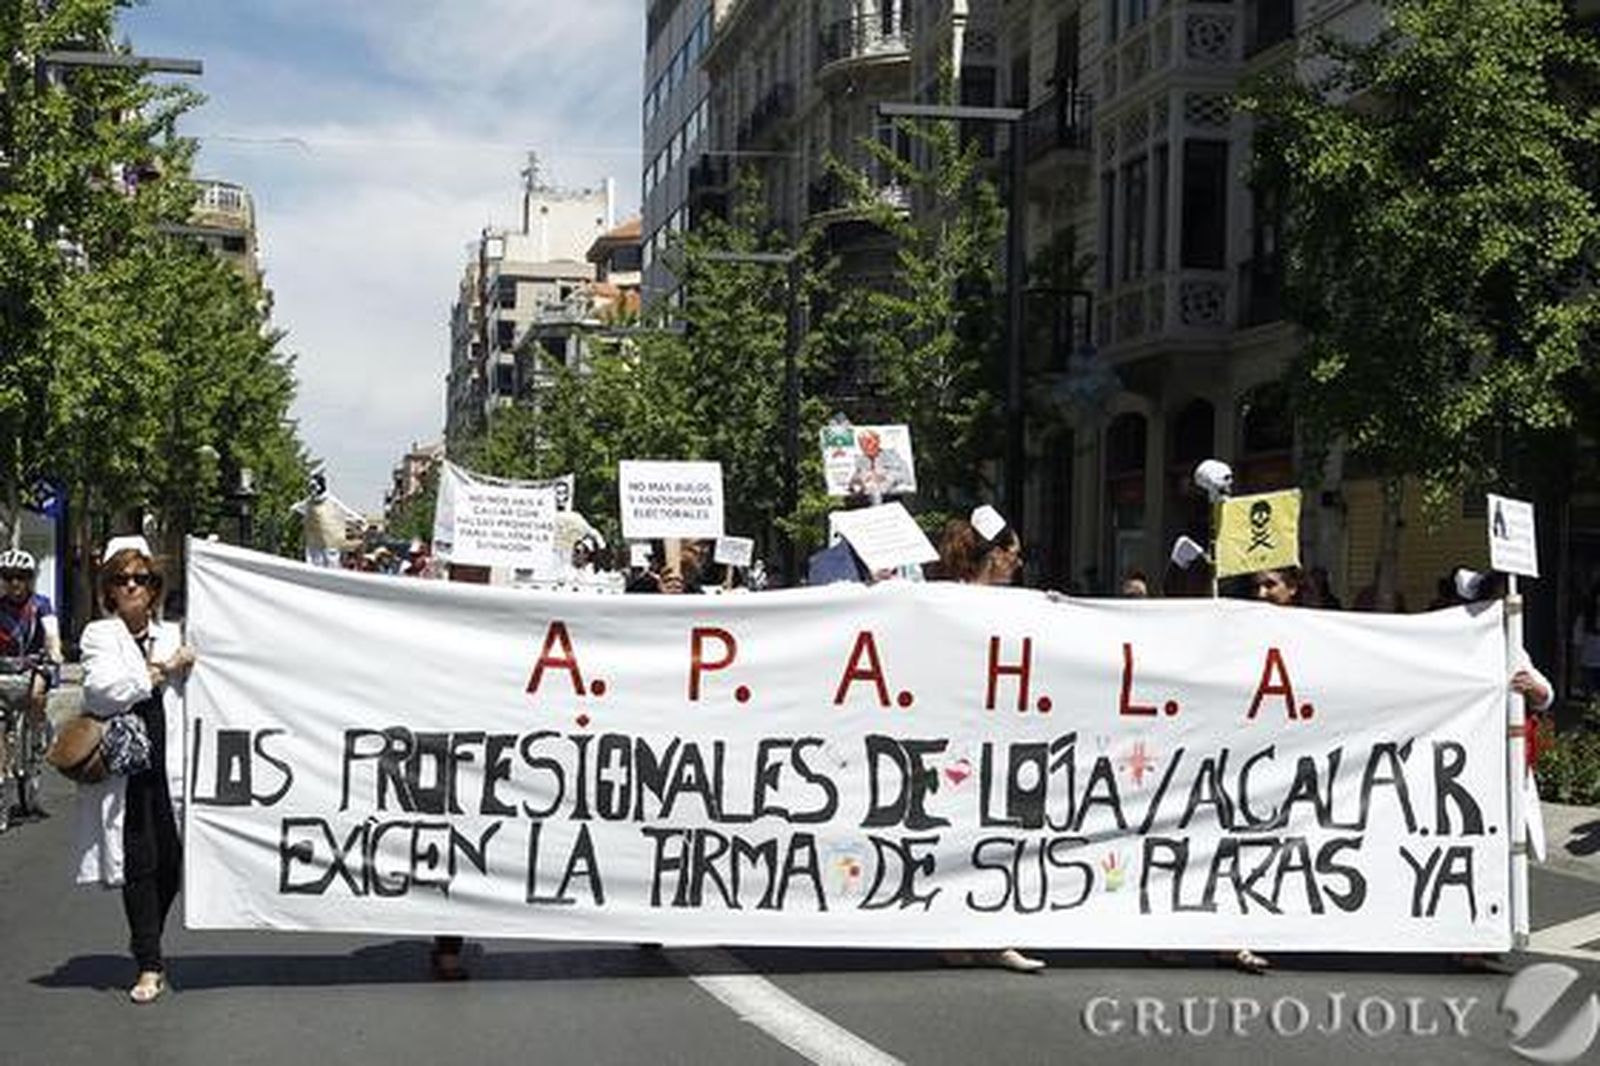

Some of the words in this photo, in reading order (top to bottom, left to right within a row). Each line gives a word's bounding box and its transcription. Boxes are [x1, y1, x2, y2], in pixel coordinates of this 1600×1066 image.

[628, 482, 646, 492] NO
[633, 507, 709, 519] ELECTORALES
[526, 621, 606, 698] A.
[689, 627, 750, 703] P.
[835, 630, 913, 708] A.
[986, 636, 1052, 713] H.
[1120, 643, 1179, 717] L.
[1248, 647, 1314, 720] A.
[190, 718, 294, 807] LOS
[340, 715, 838, 824] PROFESIONALES
[861, 733, 951, 832] DE
[527, 821, 604, 906] LA
[641, 826, 828, 912] FIRMA
[858, 835, 941, 911] DE
[966, 836, 1094, 914] SUS
[1140, 836, 1367, 915] PLAZAS
[1399, 845, 1499, 923] YA.
